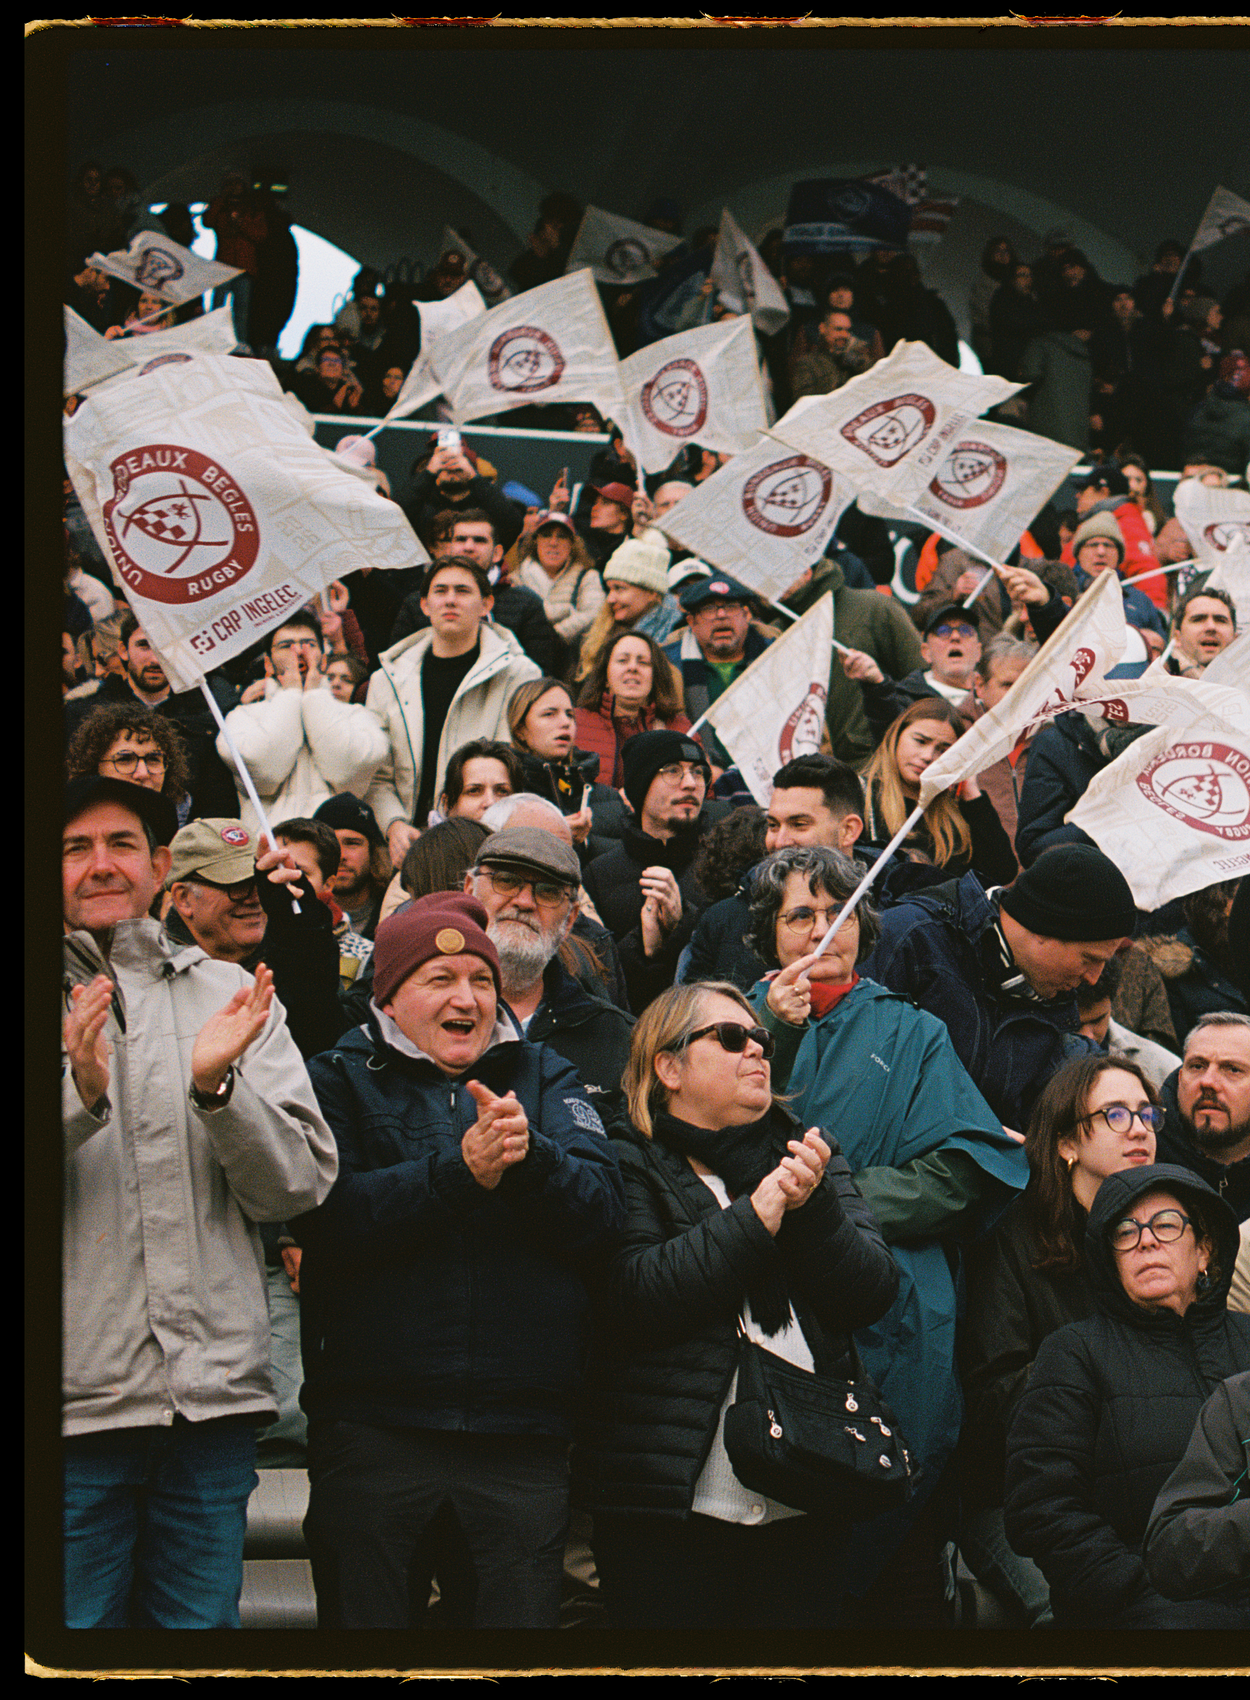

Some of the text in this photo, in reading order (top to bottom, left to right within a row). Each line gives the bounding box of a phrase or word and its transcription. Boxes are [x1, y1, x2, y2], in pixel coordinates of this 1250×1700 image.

[113, 450, 188, 487] DEAUX
[202, 465, 254, 532] BEGLES
[187, 559, 243, 595] RUGBY
[211, 609, 242, 642] CAP
